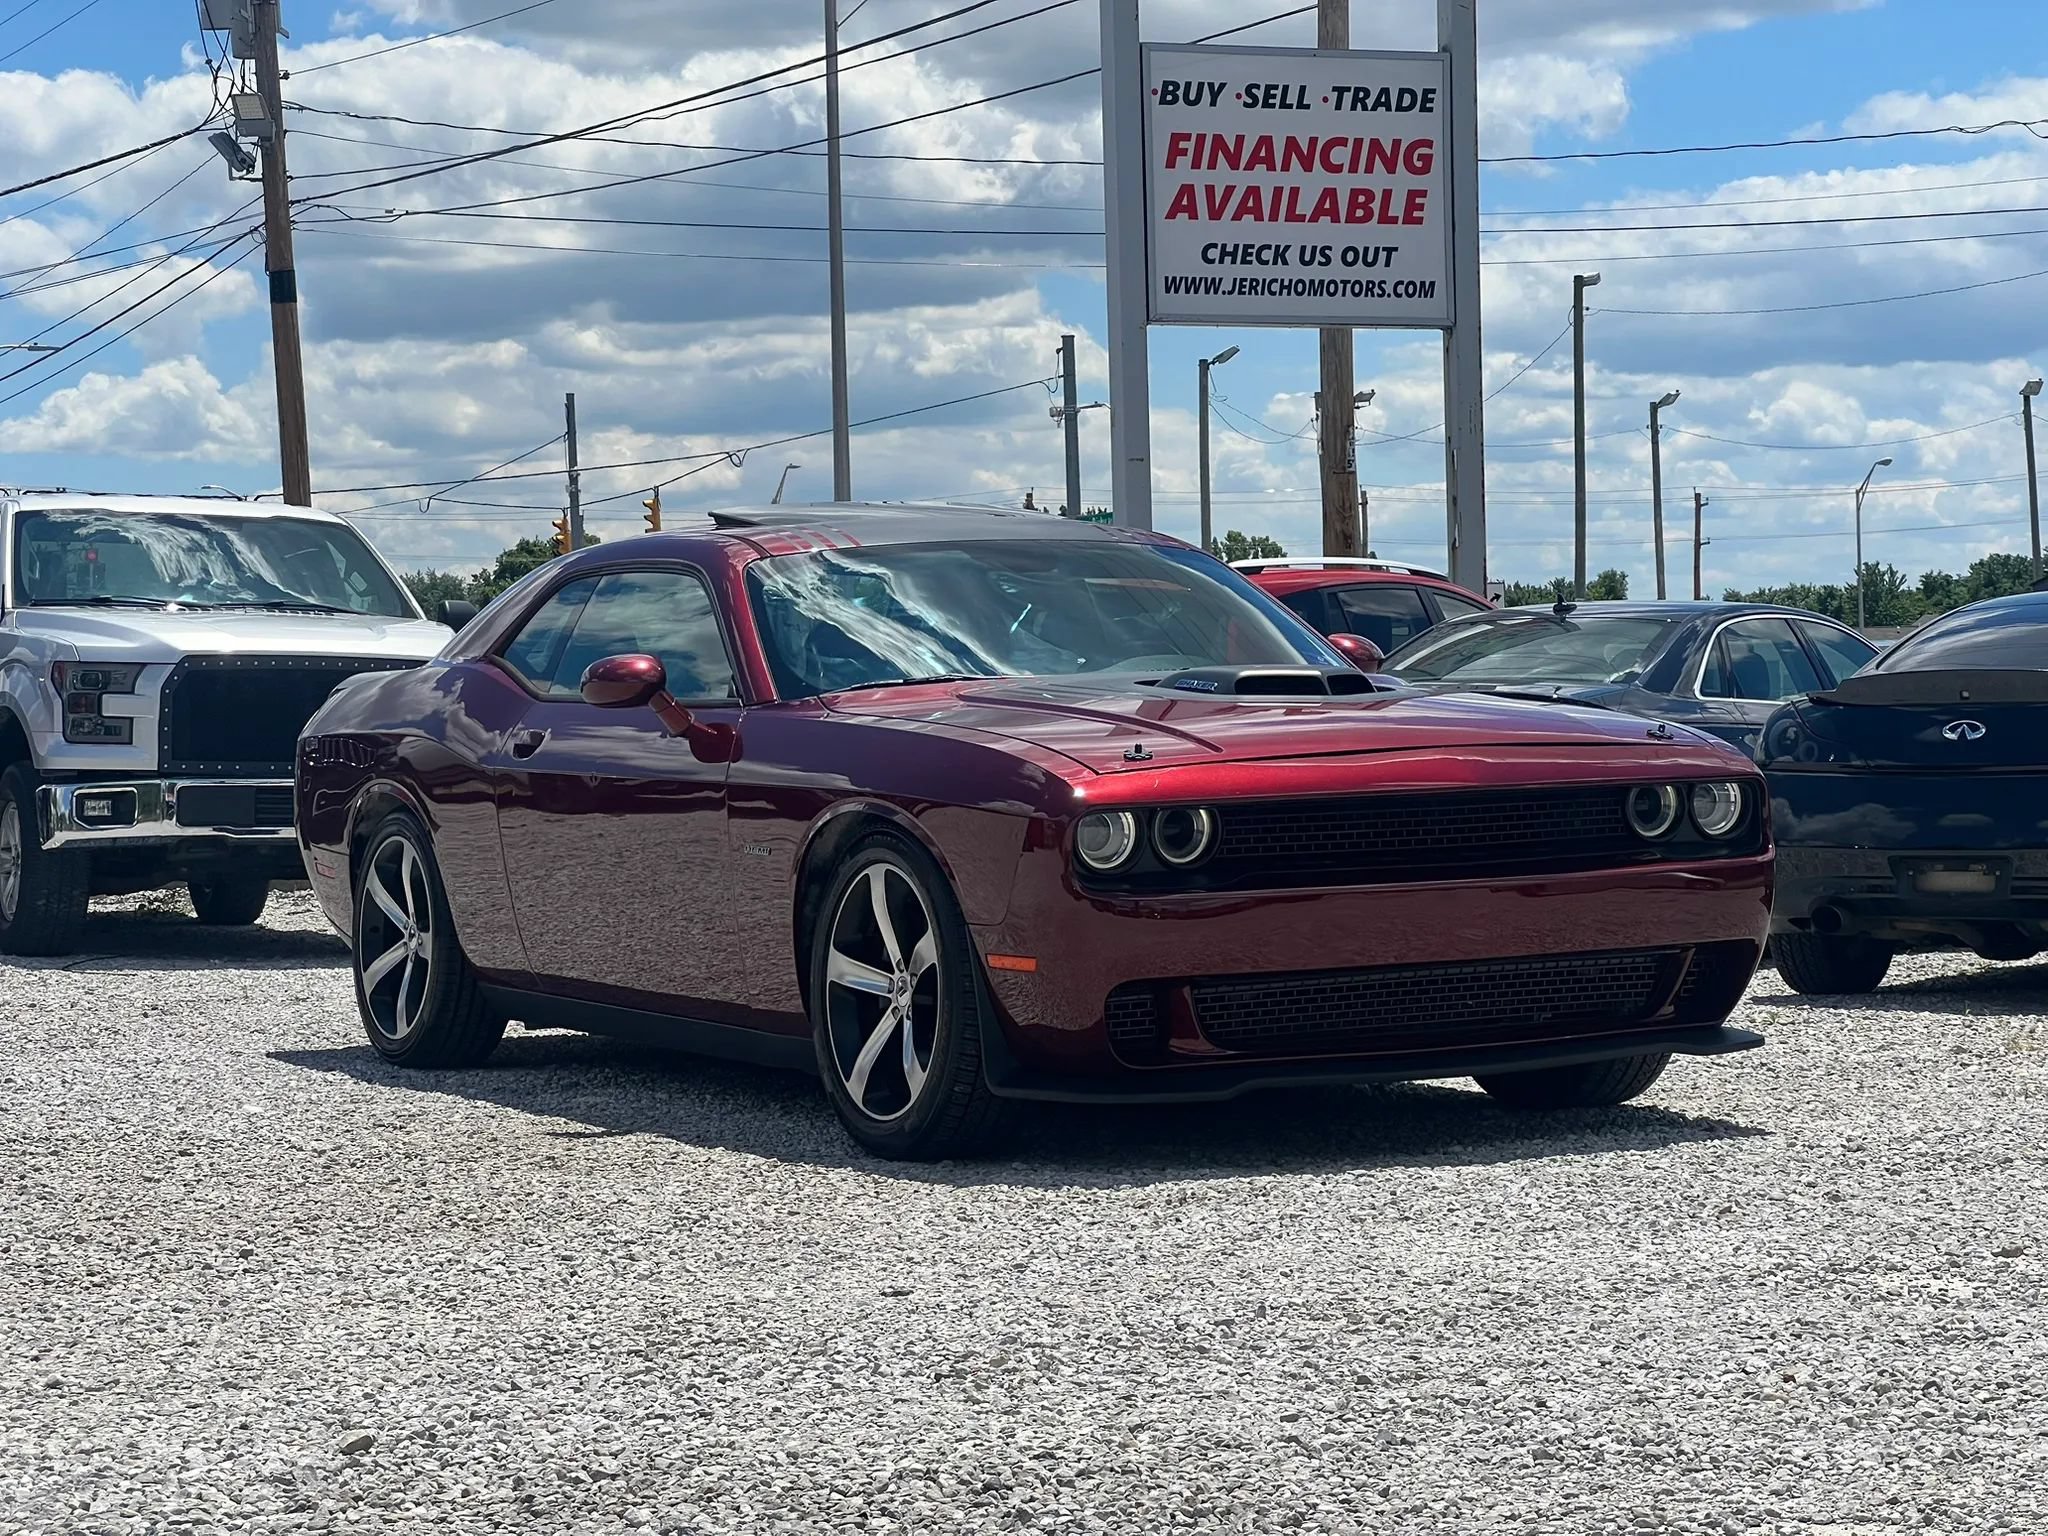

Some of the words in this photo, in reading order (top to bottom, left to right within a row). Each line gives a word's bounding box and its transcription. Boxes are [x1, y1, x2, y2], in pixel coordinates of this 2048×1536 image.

[1164, 132, 1435, 176] FINANCING
[1164, 183, 1428, 225] AVAILABLE
[1200, 242, 1291, 266] CHECK
[1299, 245, 1332, 267] US
[1340, 246, 1399, 268] OUT
[1163, 275, 1436, 299] WWW.JERICHOMOTORS.COM
